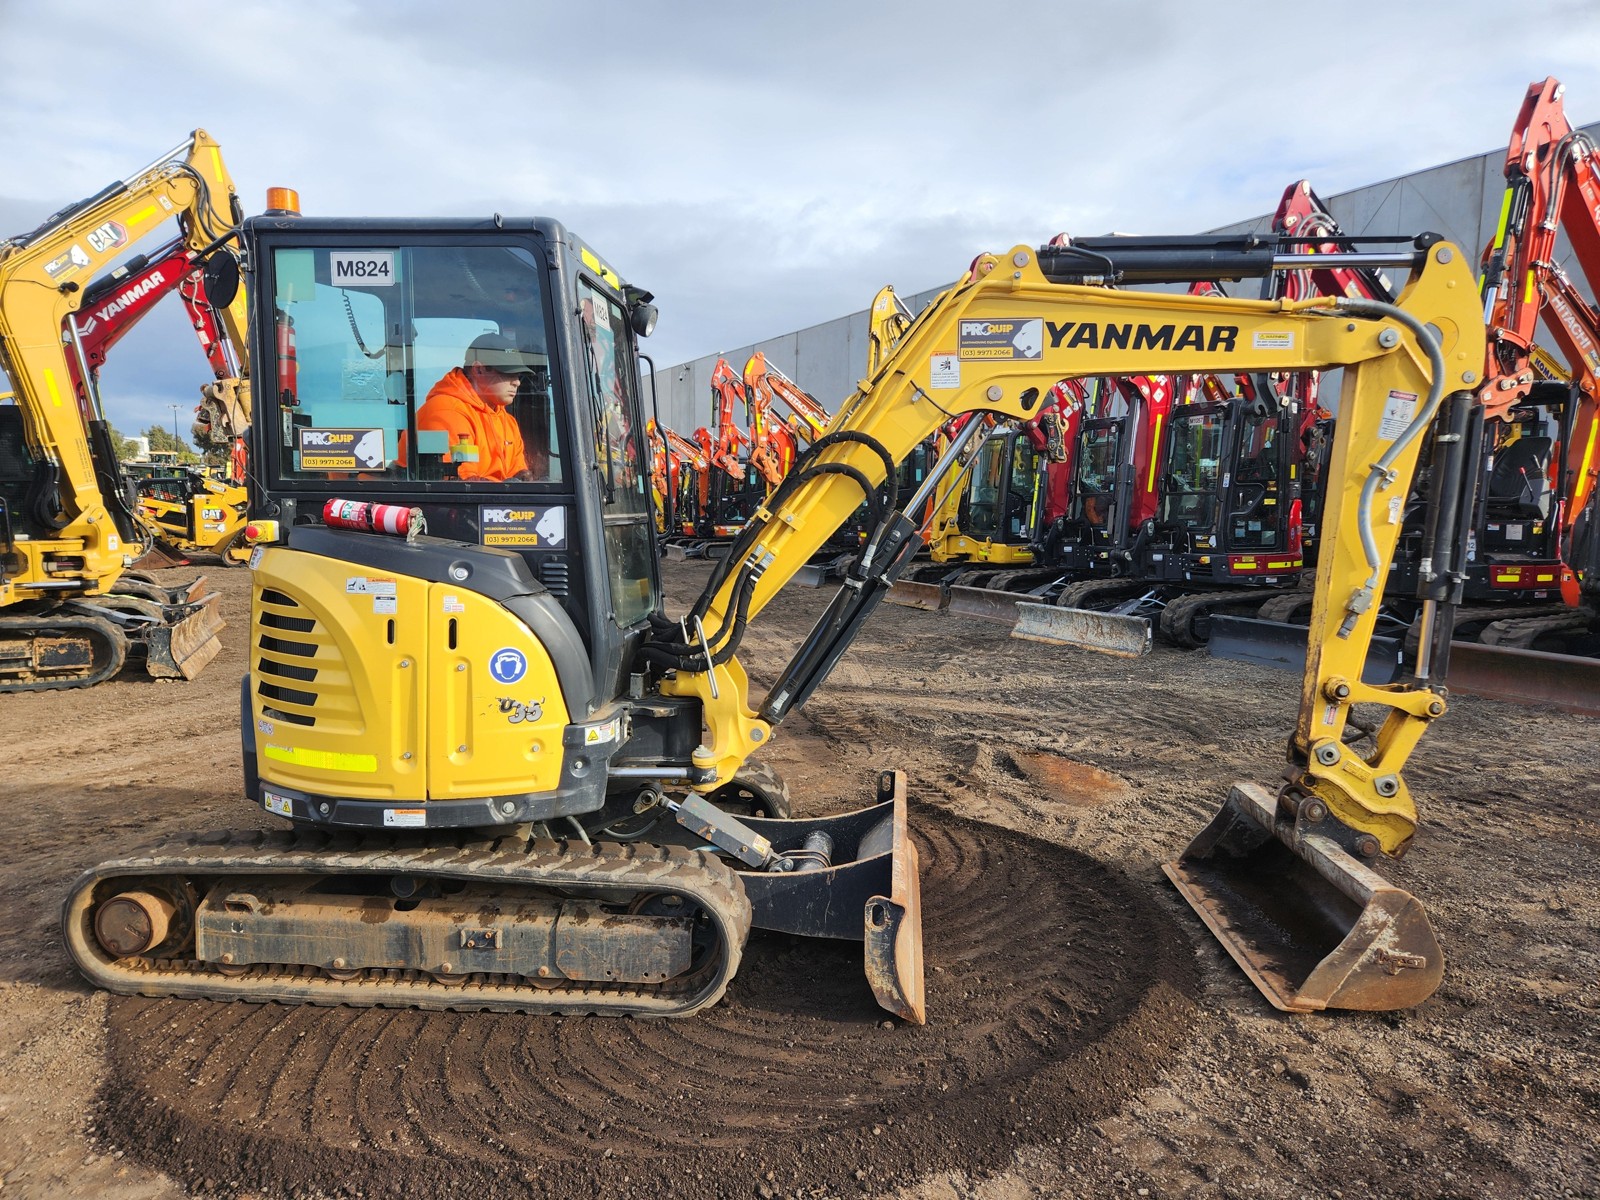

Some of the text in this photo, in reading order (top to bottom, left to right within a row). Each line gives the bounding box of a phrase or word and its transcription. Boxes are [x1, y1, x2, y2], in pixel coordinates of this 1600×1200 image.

[87, 222, 120, 252] CAT
[336, 260, 390, 277] M824
[96, 271, 165, 321] YANMAR
[1045, 321, 1239, 352] YANMAR
[1552, 294, 1592, 349] HITACHI
[202, 509, 222, 520] CAT
